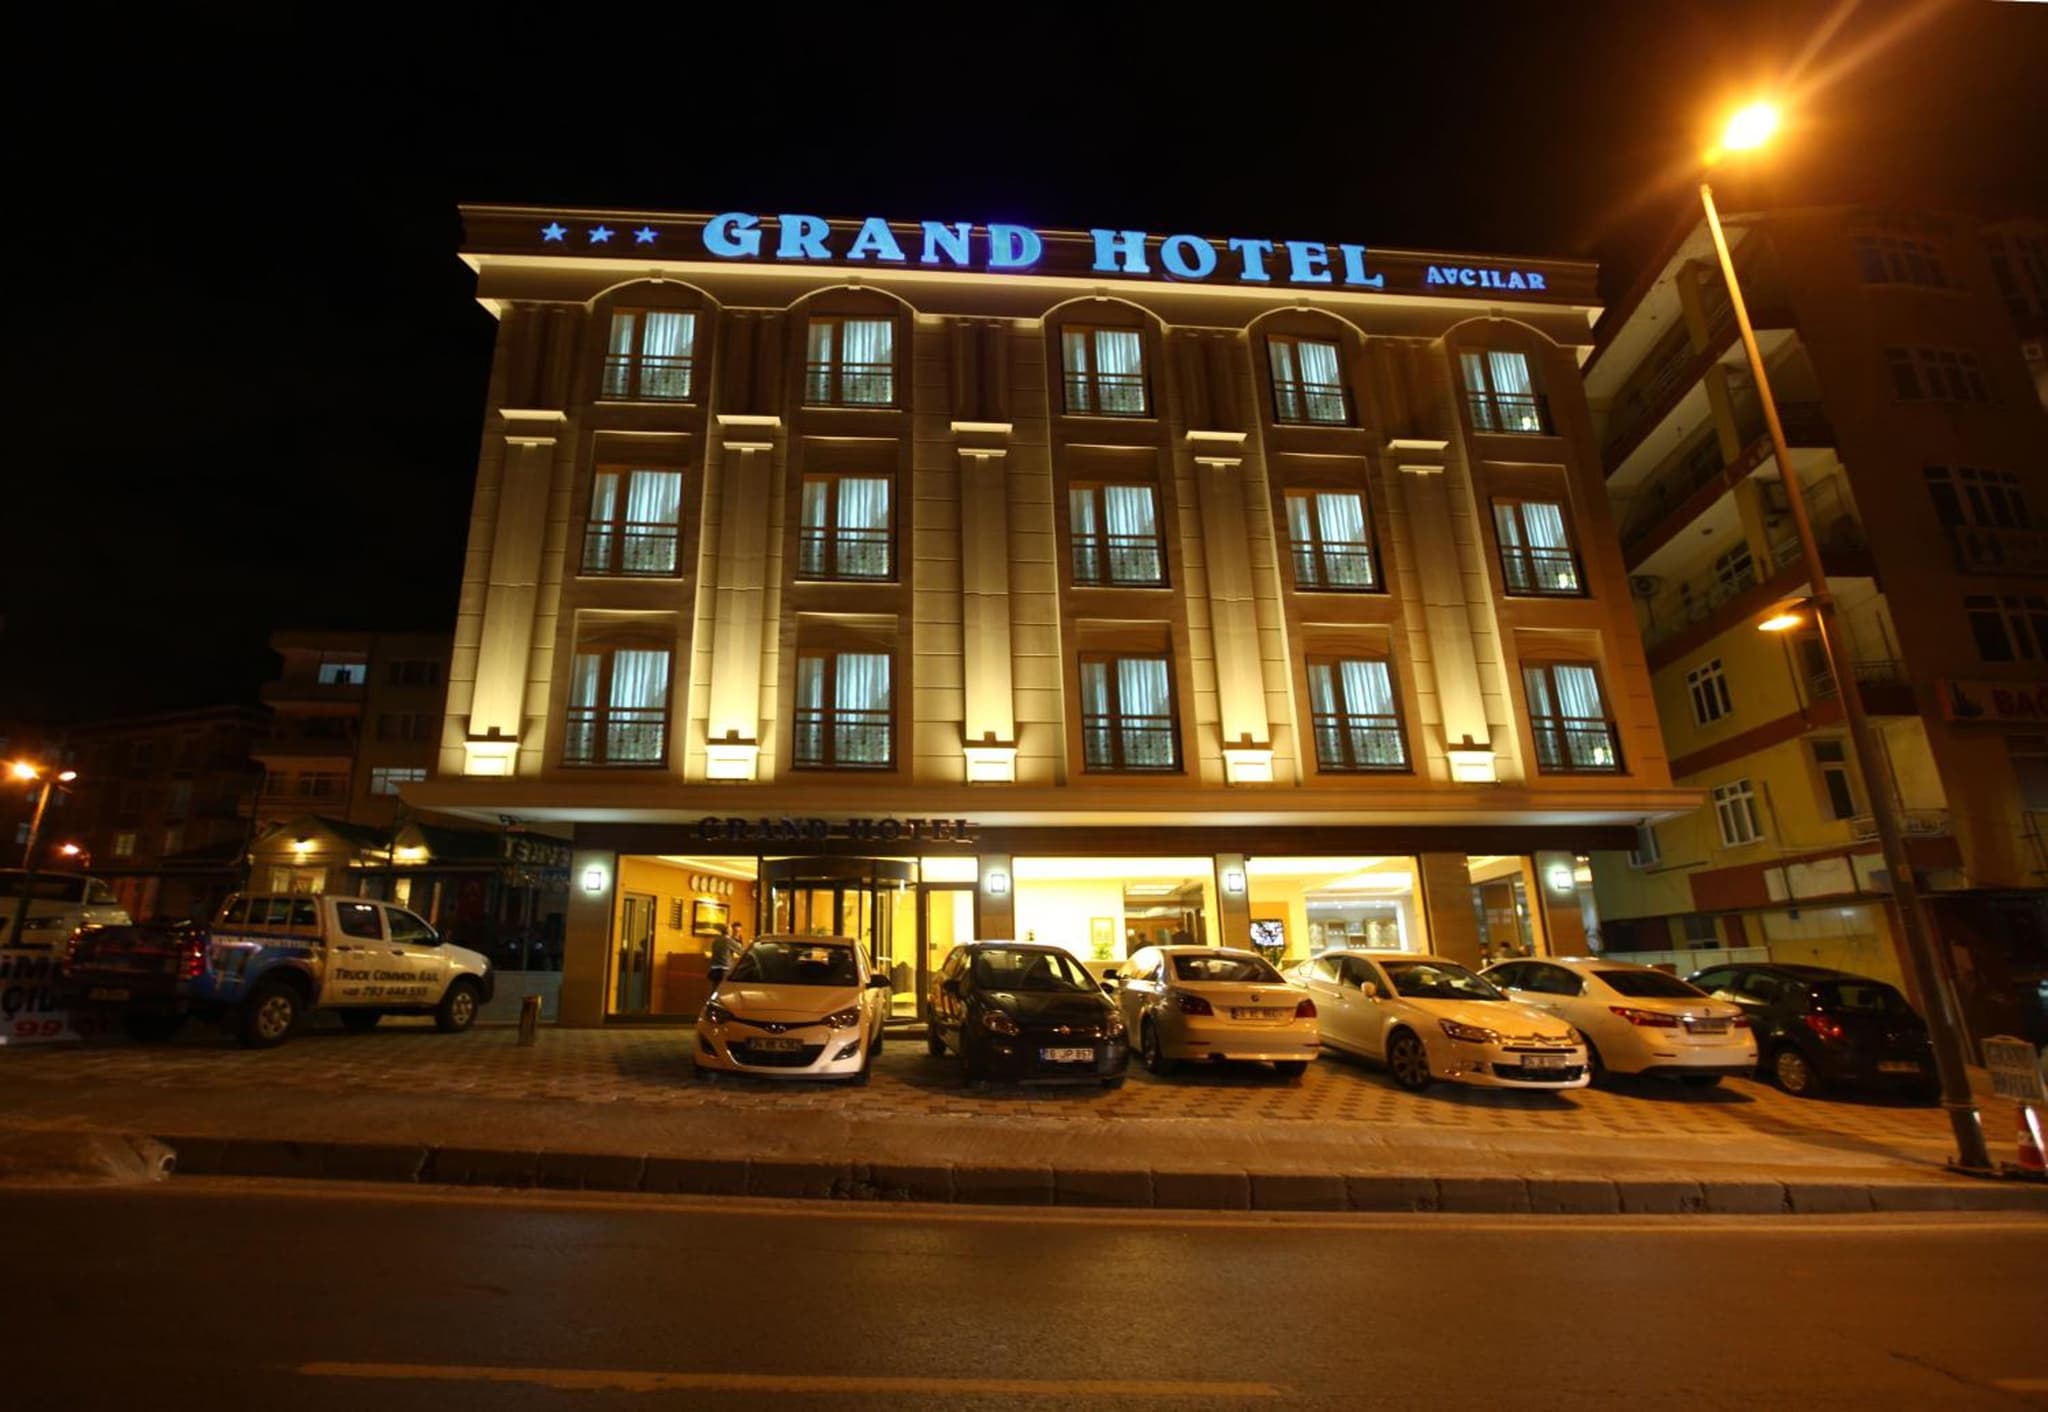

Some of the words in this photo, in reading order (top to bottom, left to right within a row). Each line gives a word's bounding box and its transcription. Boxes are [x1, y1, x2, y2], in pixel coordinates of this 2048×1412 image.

[702, 211, 1043, 269] GRAND
[1089, 228, 1386, 288] HOTEL
[1426, 265, 1547, 291] AVCILAR
[701, 817, 828, 841] GRAND
[849, 818, 973, 844] HOTEL
[336, 968, 369, 981] TRUCK
